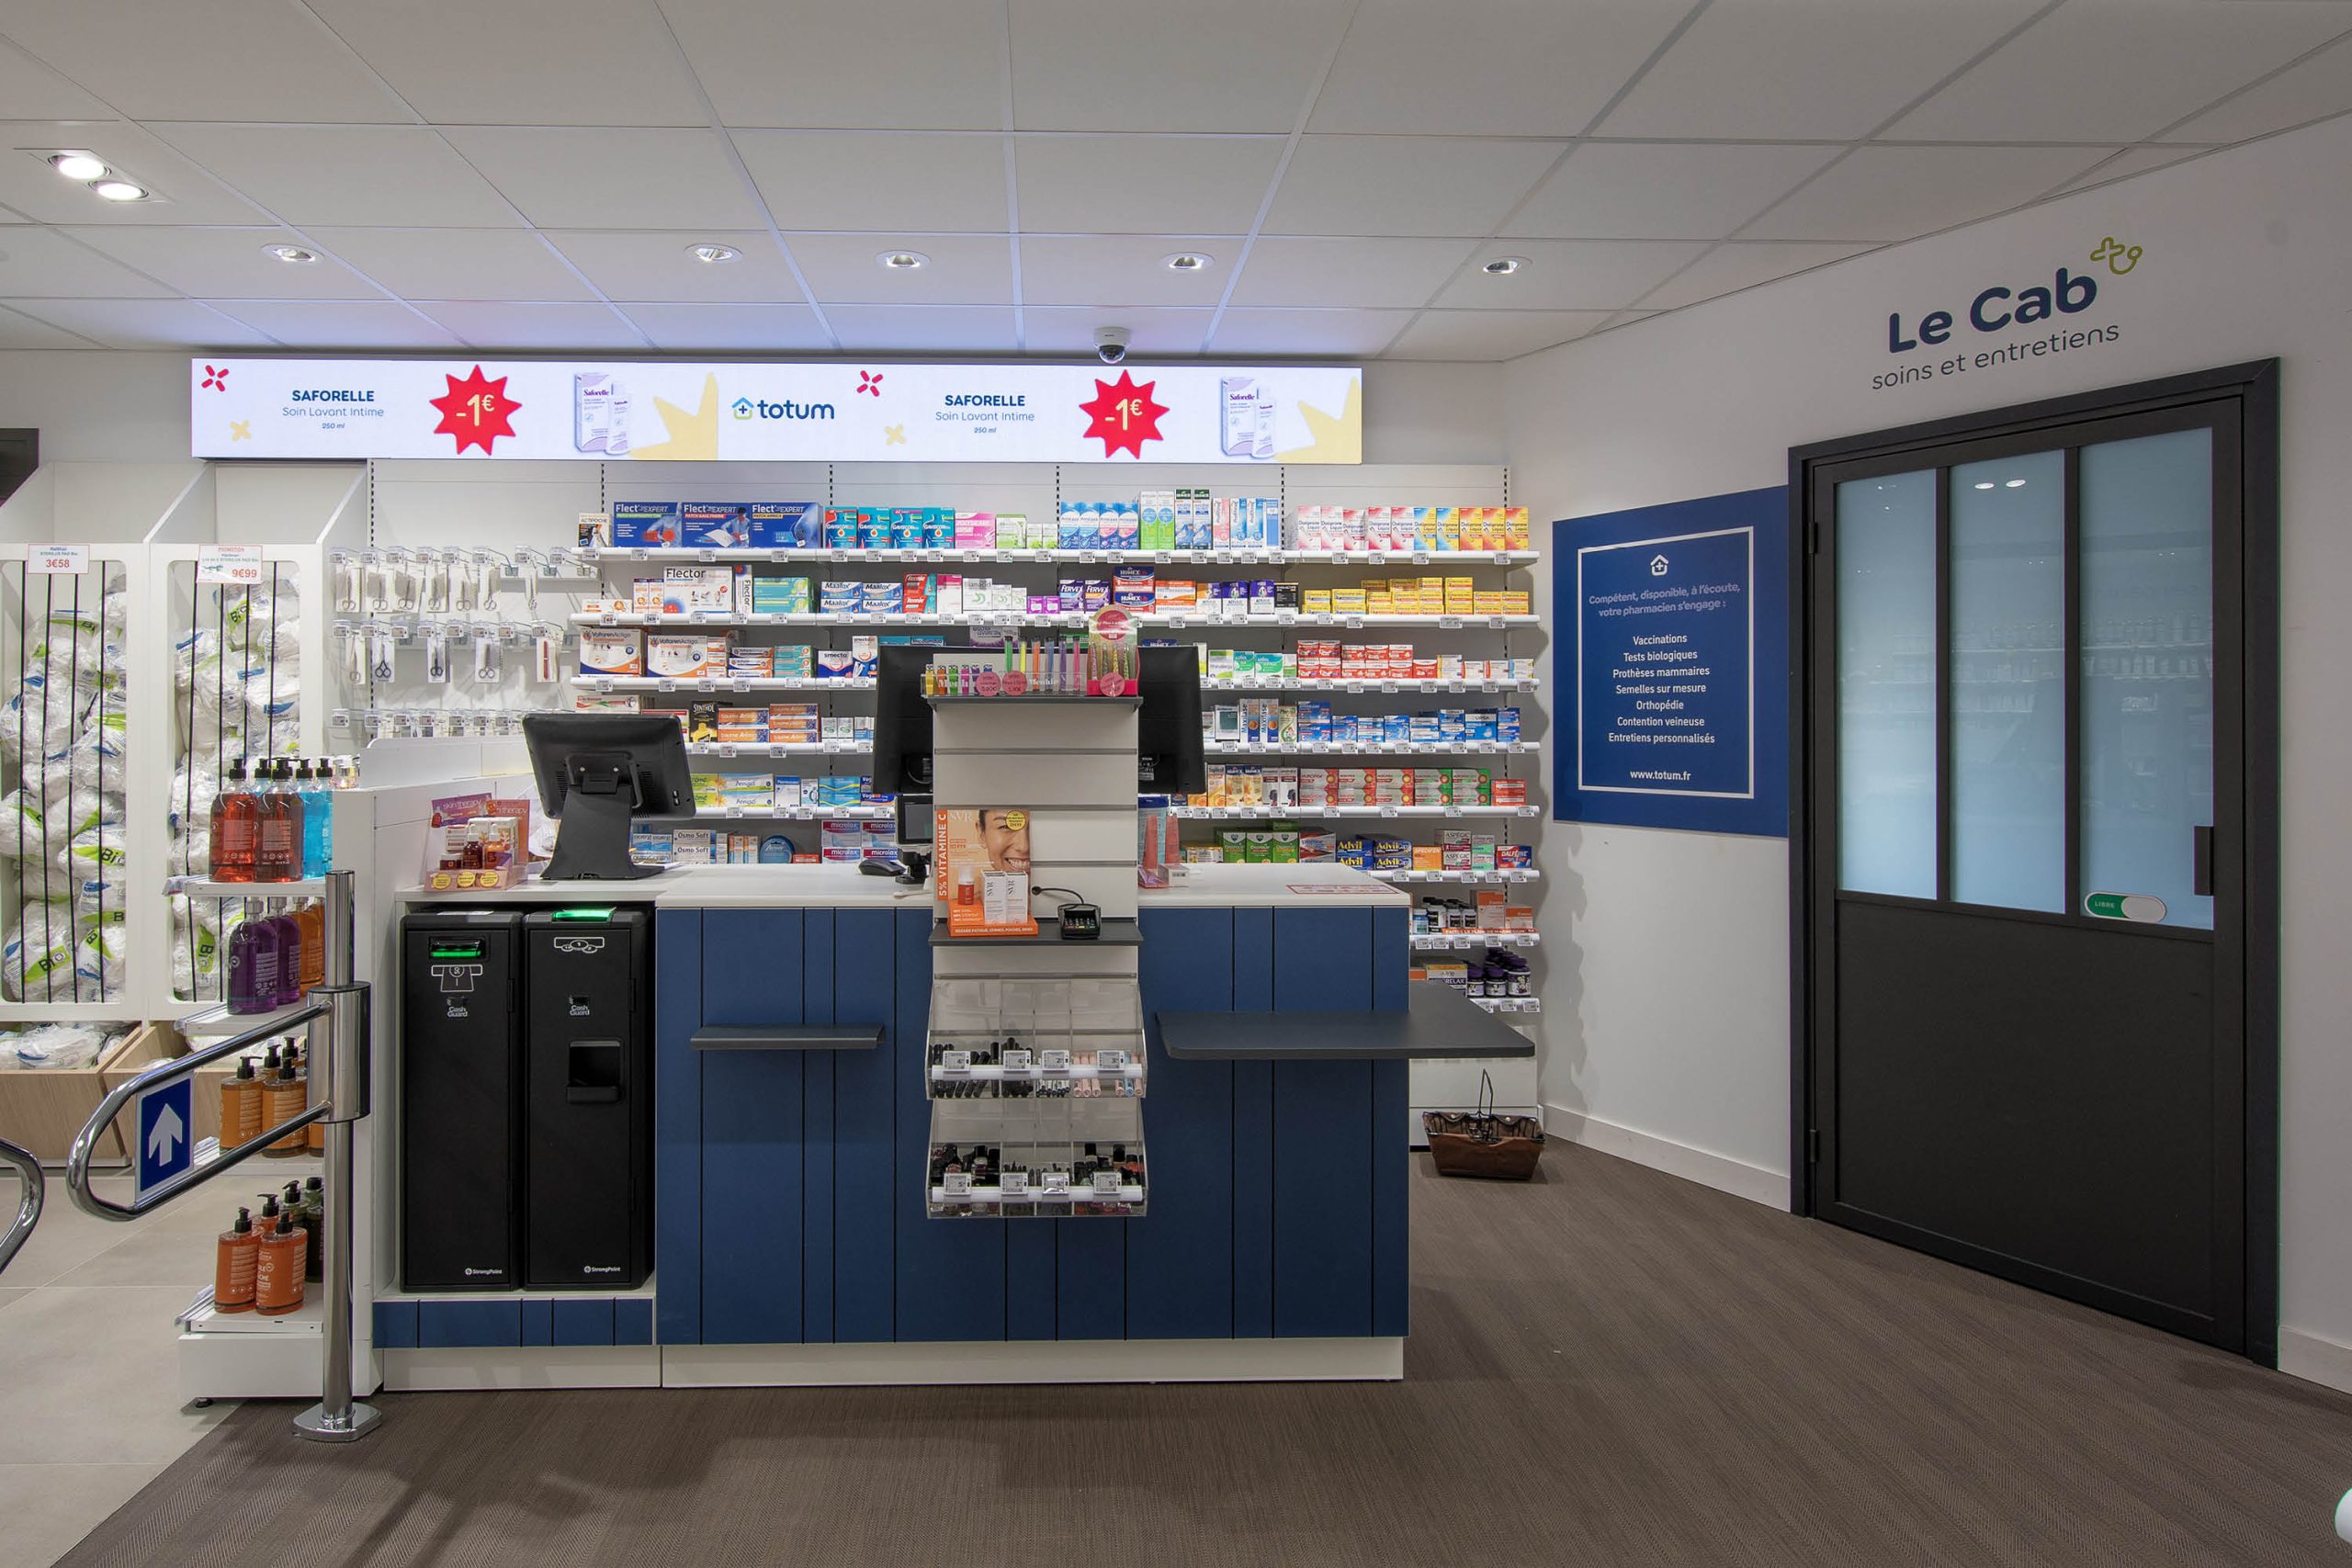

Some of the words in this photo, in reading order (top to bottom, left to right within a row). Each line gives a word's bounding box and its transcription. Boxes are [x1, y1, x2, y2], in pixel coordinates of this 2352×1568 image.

[1889, 310, 1953, 354] Le
[1969, 267, 2098, 333] Cab
[1872, 365, 1932, 389] soins
[1940, 354, 1966, 376] et
[1974, 324, 2120, 368] entretiens
[292, 389, 375, 402] SAFORELLE
[944, 394, 1025, 407] SAFORELLE
[282, 406, 308, 417] Soin
[310, 407, 343, 417] Lavant
[345, 407, 384, 418] Intime
[456, 393, 494, 427] -1€
[757, 400, 835, 420] totum
[1104, 399, 1143, 431] -1€
[935, 411, 960, 423] Soin
[963, 412, 998, 423] Lavant
[1001, 411, 1035, 423] Intime
[974, 426, 987, 434] 250
[46, 559, 70, 568] 3€58
[232, 569, 257, 578] 9€99
[666, 568, 706, 578] Flector
[1589, 591, 1639, 604] Compétent,
[1640, 586, 1689, 601] disponible,
[1690, 586, 1698, 595] à
[1699, 582, 1741, 595] l'écoute,
[1599, 607, 1622, 617] votre
[1623, 604, 1677, 617] pharmacien
[1678, 599, 1721, 613] s'engage
[1633, 633, 1688, 646] Vaccinations
[1623, 651, 1645, 662] Tests
[1646, 649, 1698, 663] biologiques
[1612, 667, 1655, 679] Prothèses
[1657, 665, 1710, 677] mammaires
[1616, 683, 1655, 694] Semelles
[1657, 684, 1671, 694] sur
[1672, 683, 1706, 694] mesure
[693, 704, 715, 713] SYNTHOL
[1636, 700, 1684, 712] Orthopédie
[1617, 716, 1663, 727] Contention
[1666, 716, 1705, 727] veineuse
[1609, 733, 1652, 743] Entretiens
[1653, 733, 1715, 745] personnalisés
[1630, 770, 1691, 782] www.totum.fr
[950, 811, 972, 821] SVR
[938, 824, 947, 878] VITAMINE
[1338, 841, 1363, 850] Advil
[1340, 857, 1363, 865] Advil
[938, 881, 947, 897] 5%
